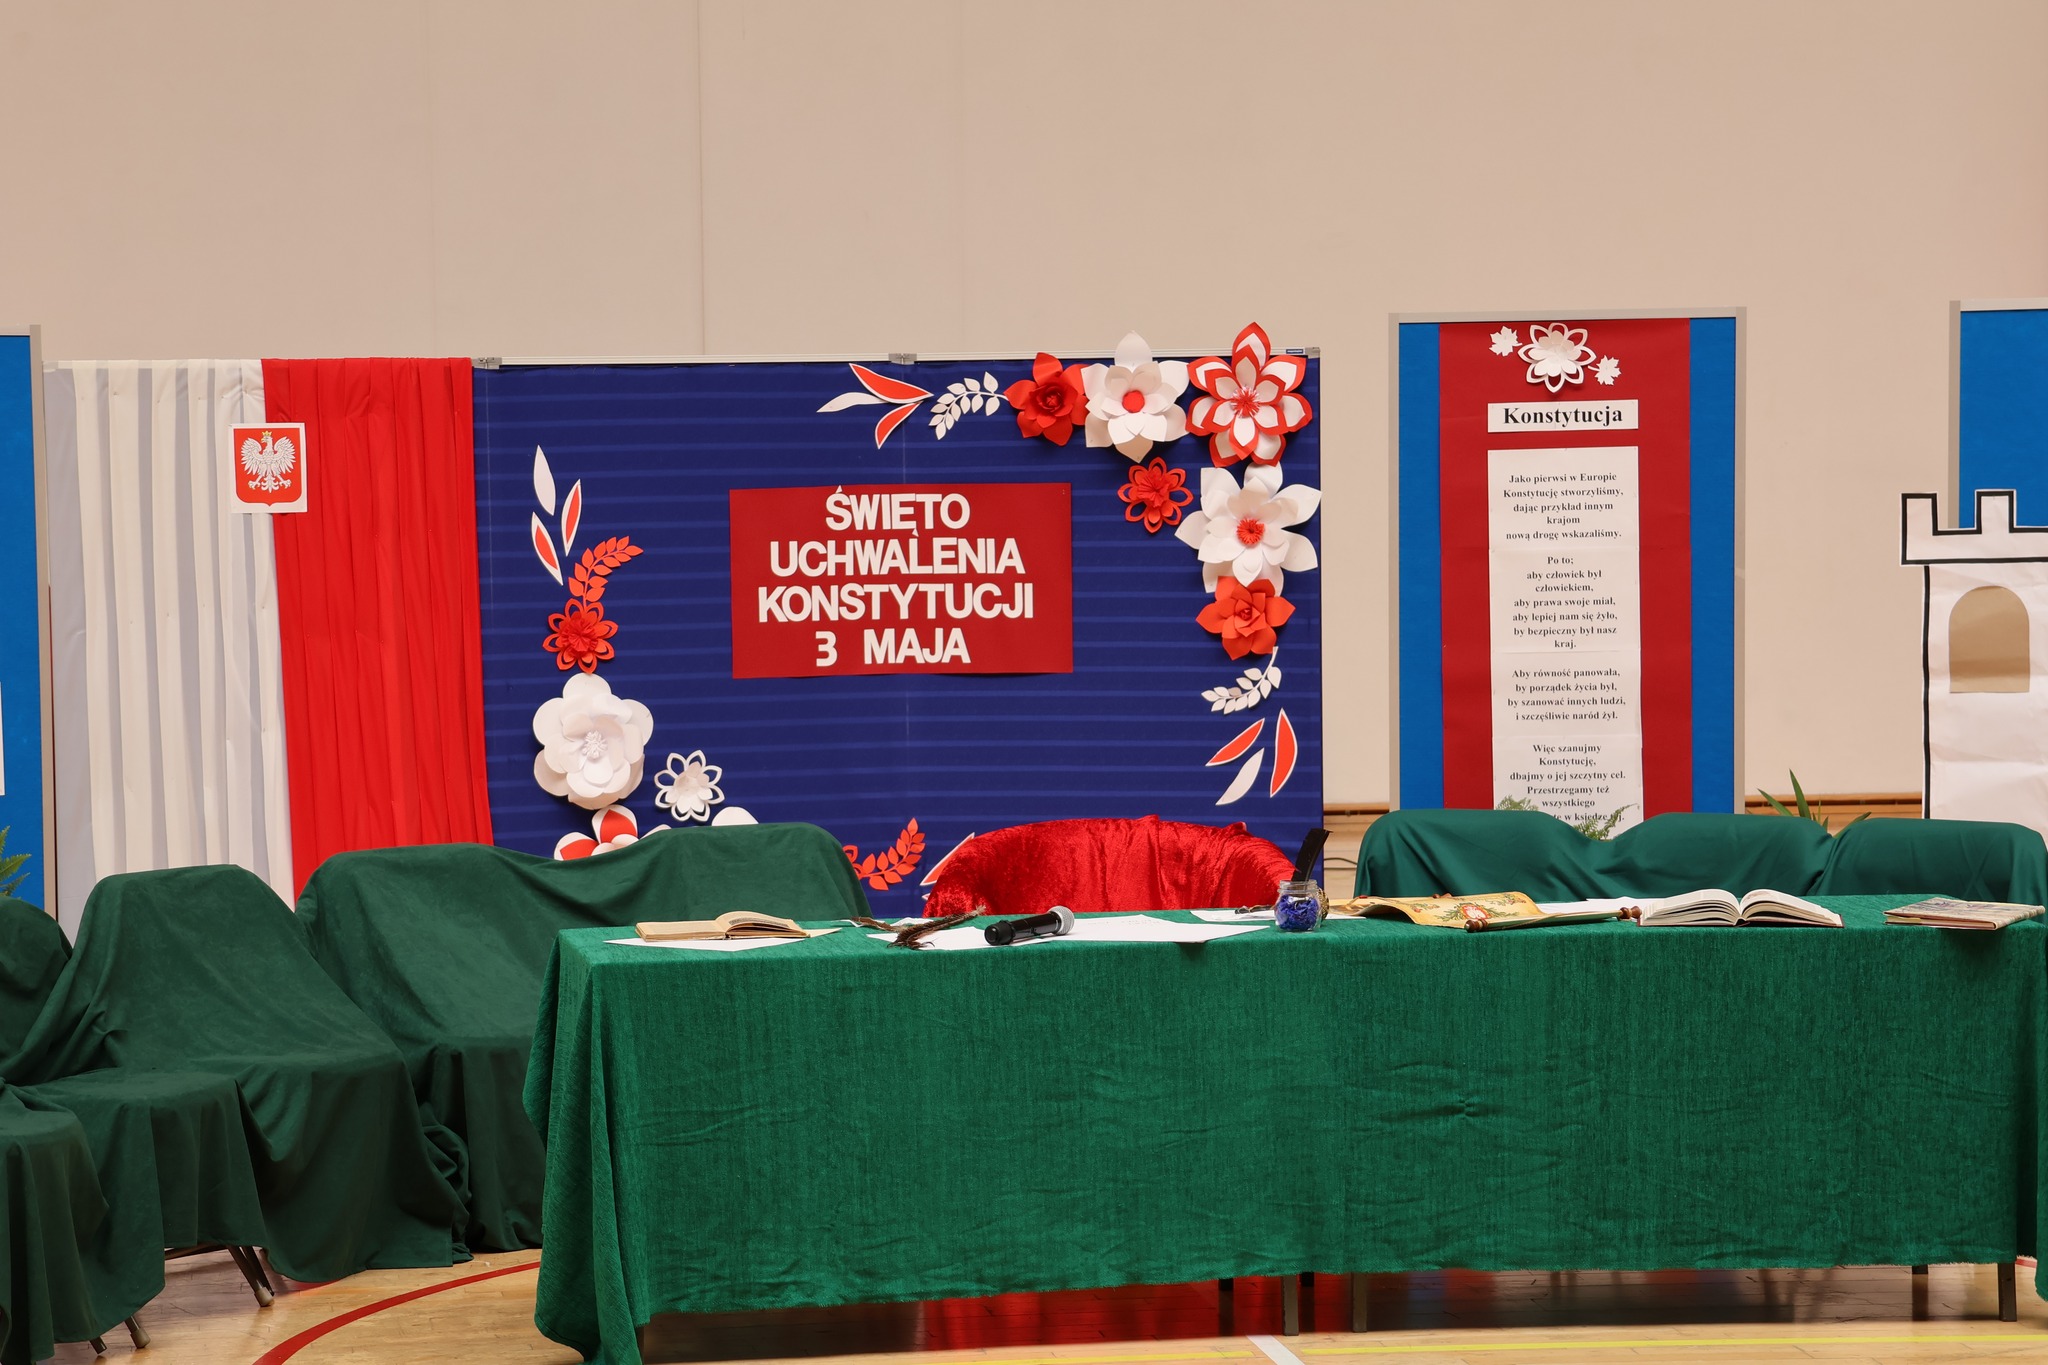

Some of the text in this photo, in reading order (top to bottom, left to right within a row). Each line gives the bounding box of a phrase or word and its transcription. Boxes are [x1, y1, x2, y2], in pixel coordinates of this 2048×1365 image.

[1504, 406, 1623, 427] Konstytucja
[1509, 475, 1531, 483] Jako
[1534, 474, 1566, 484] pierwsi
[1580, 473, 1616, 483] Europie
[1504, 487, 1623, 499] Konstytucję stworzyliśmy,
[826, 485, 971, 536] ŚWIĘTO
[1514, 502, 1613, 513] dając przykład innym
[1547, 516, 1580, 526] krajom
[1506, 529, 1621, 541] nową drogę wskazaliśmy.
[769, 537, 1026, 576] UCHWALENIA
[1527, 570, 1601, 581] aby człowiek był
[1535, 583, 1593, 592] człowiekiem,
[758, 583, 1034, 623] KONSTYTUCJI
[1514, 597, 1615, 608] aby prawa swoje miał,
[1513, 613, 1529, 623] aby
[1532, 613, 1556, 623] lepiej
[1582, 612, 1593, 622] się
[1597, 612, 1617, 621] żyło,
[1514, 628, 1524, 637] by
[1528, 627, 1577, 637] bezpieczny
[1580, 626, 1593, 636] był
[815, 628, 971, 667] 3 MAJA
[1555, 640, 1576, 649] kraj.
[1512, 668, 1620, 679] Aby równość panowała,
[1516, 683, 1617, 694] by porządek życia był,
[1508, 697, 1625, 708] by szanować innych ludzi,
[1522, 712, 1569, 722] szczęśliwie
[1573, 711, 1599, 719] naród
[1602, 711, 1618, 721] żył.
[1533, 744, 1601, 754] Więc szanujmy
[1540, 757, 1596, 767] Konstytucję,
[1510, 772, 1544, 782] dbajmy
[1555, 772, 1566, 782] jej
[1570, 772, 1607, 781] szczytny
[1611, 771, 1625, 779] cel.
[1527, 786, 1594, 796] Przestrzegamy
[1542, 799, 1595, 808] wszystkiego
